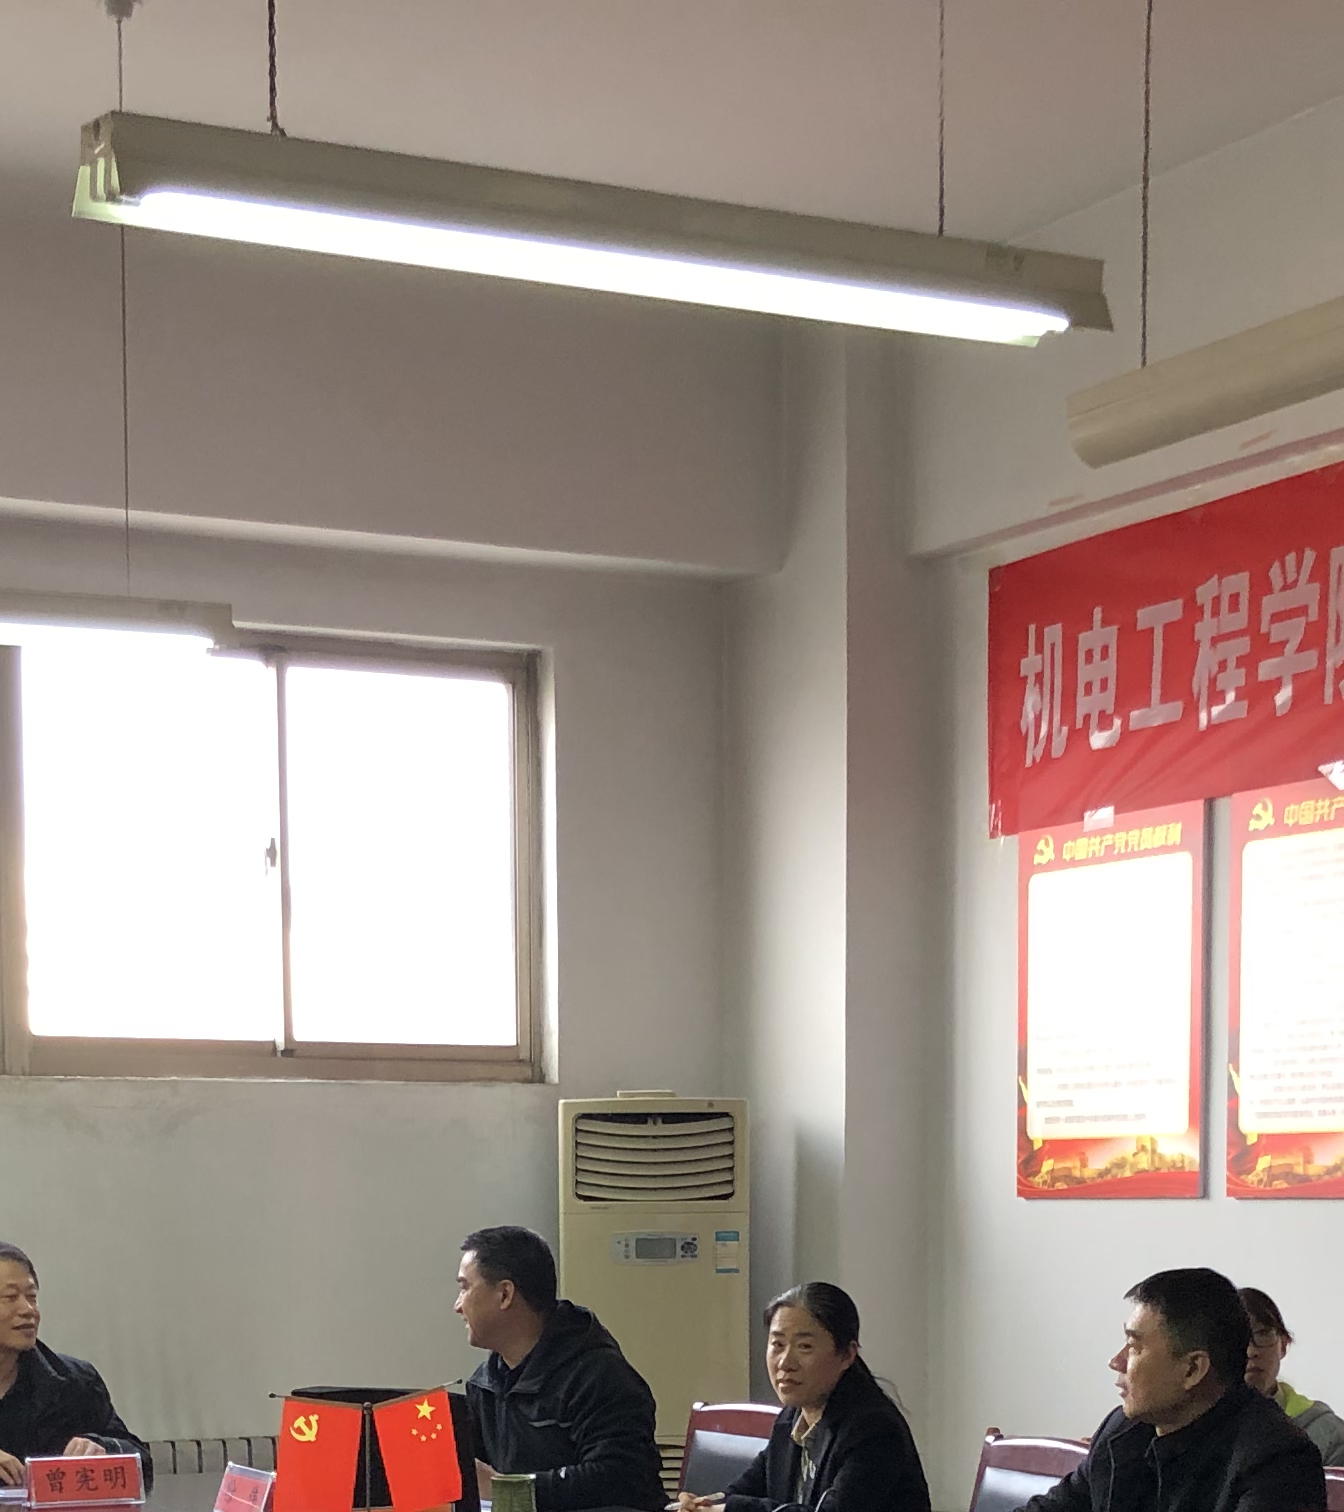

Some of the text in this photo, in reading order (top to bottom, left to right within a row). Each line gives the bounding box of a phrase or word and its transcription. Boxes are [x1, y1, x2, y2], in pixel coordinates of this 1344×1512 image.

[1062, 822, 1182, 862] 中国共产党党员权利
[46, 1465, 126, 1493] 曾宪明
